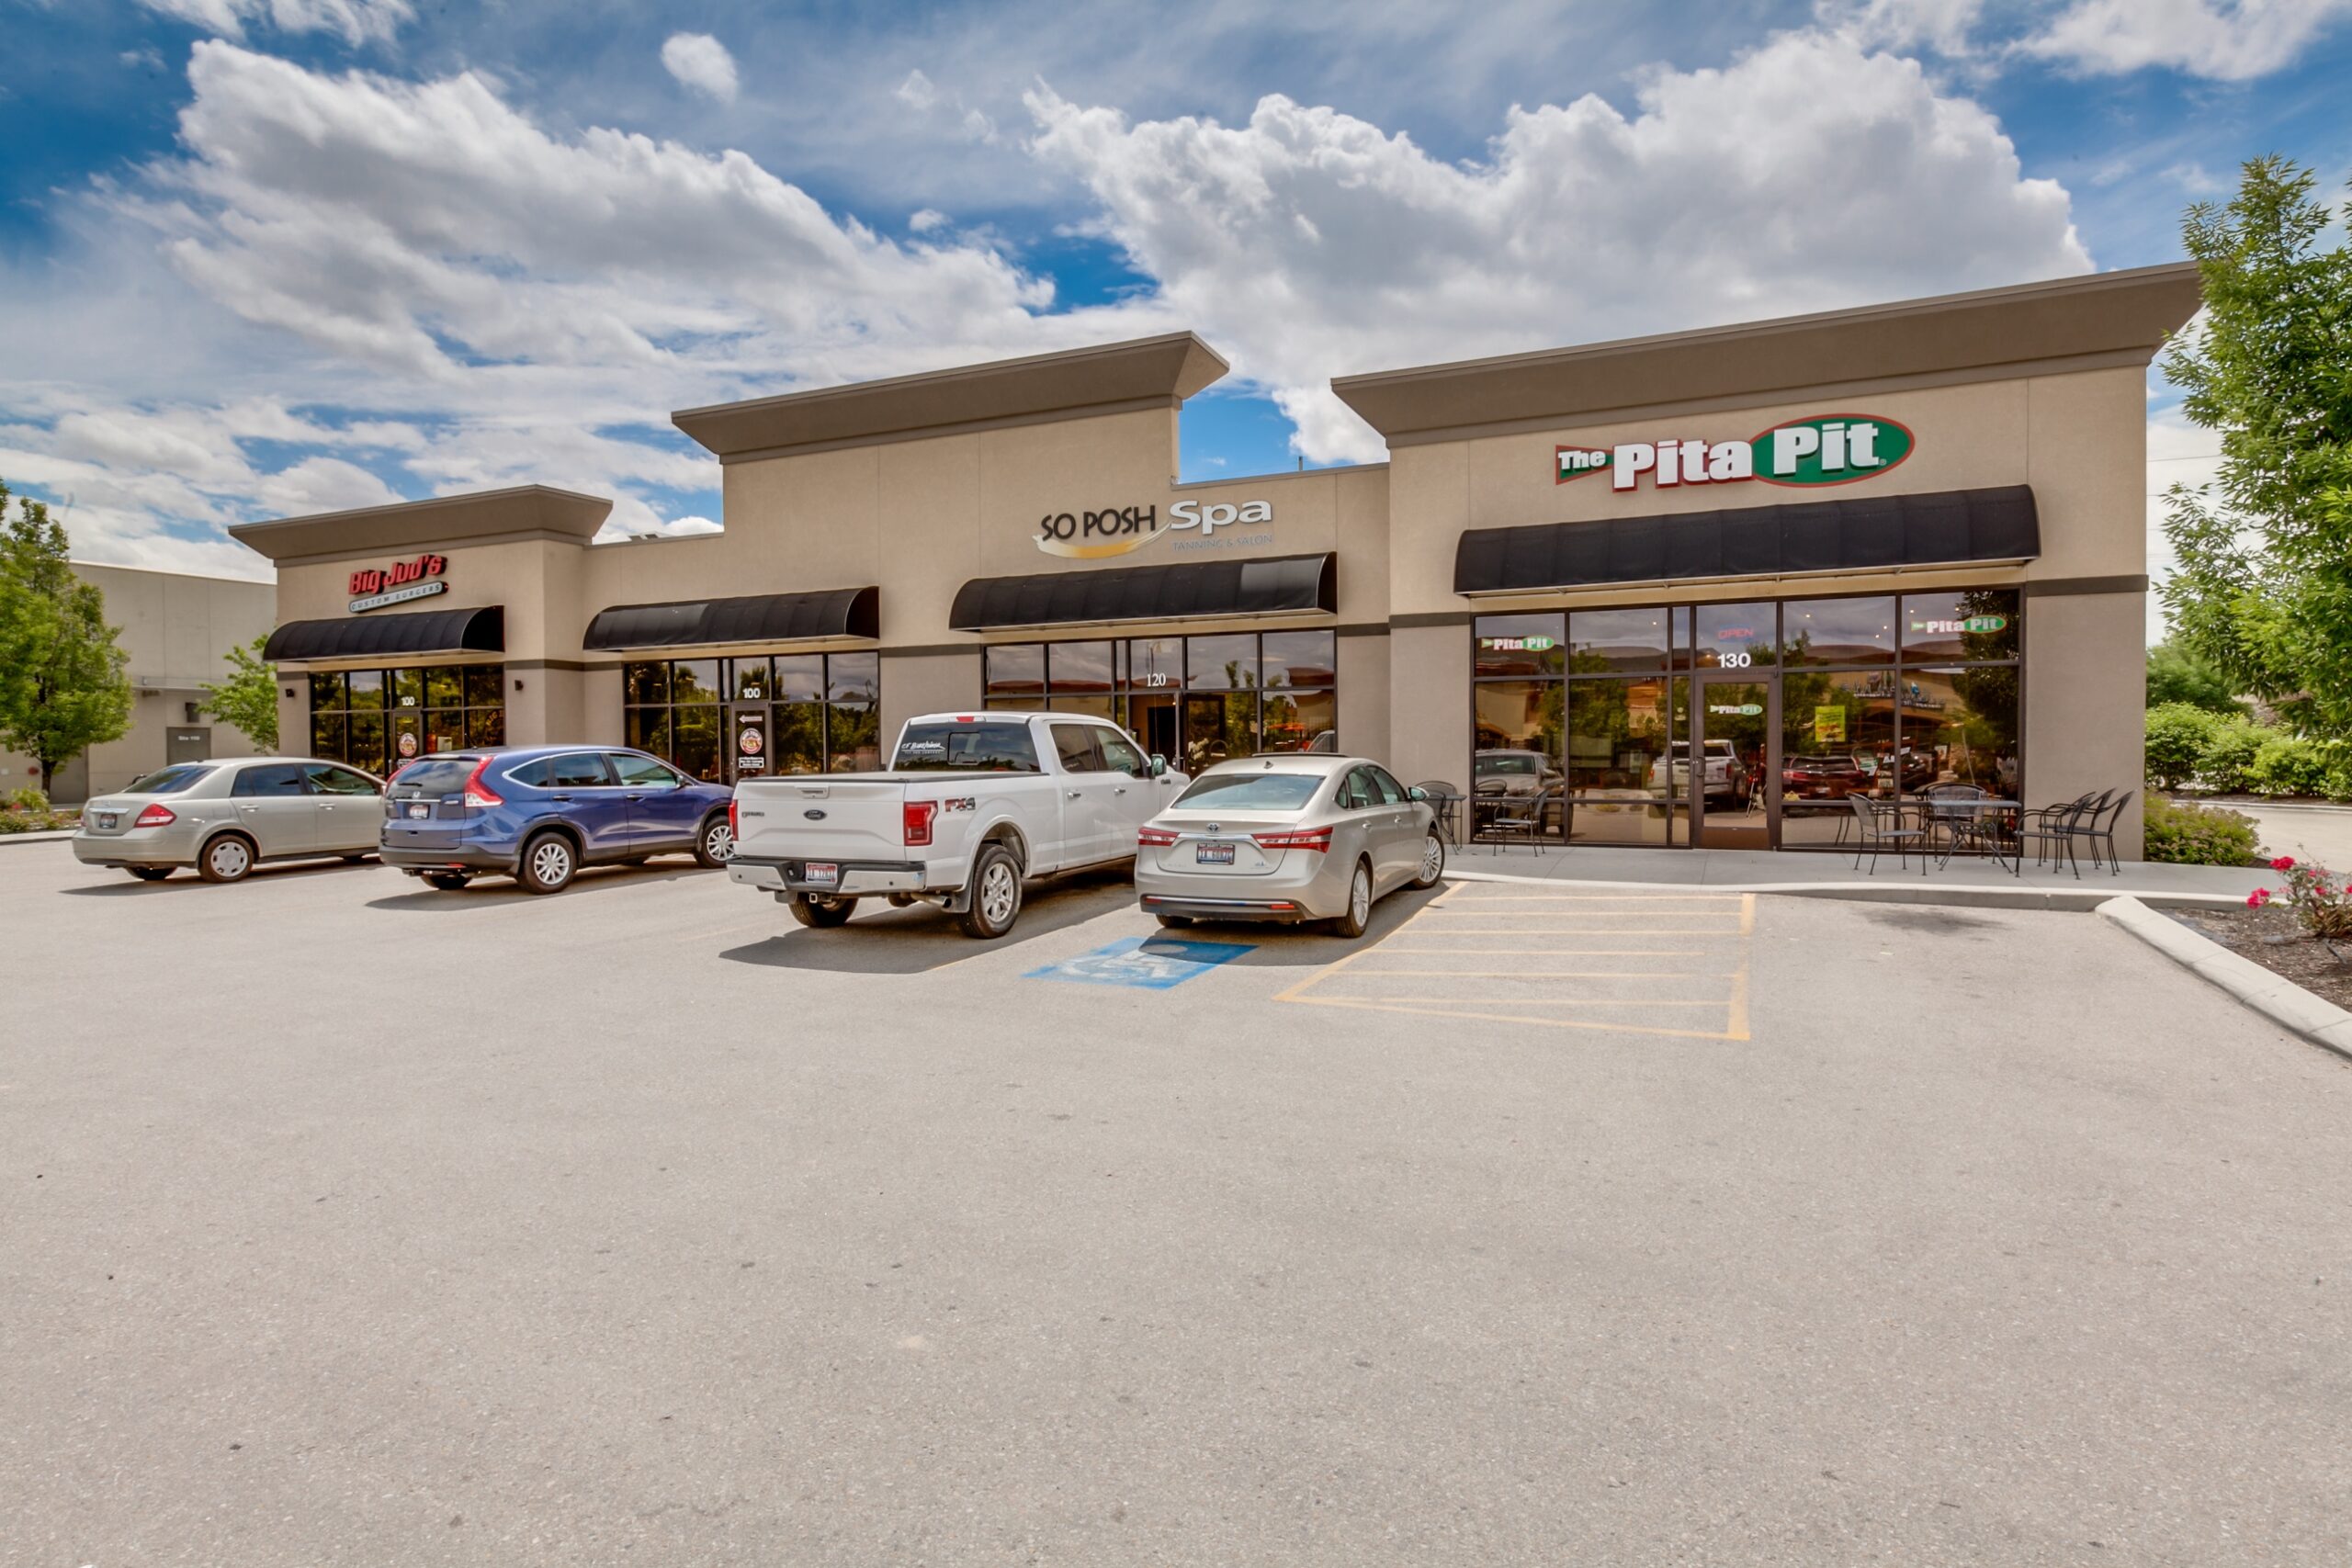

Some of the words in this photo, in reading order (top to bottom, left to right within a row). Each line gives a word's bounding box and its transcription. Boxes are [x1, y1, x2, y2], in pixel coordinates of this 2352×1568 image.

[1557, 449, 1607, 472] The
[1612, 438, 1753, 490] Pita
[1772, 422, 1880, 477] Pit
[1041, 513, 1077, 542] SO
[1083, 504, 1156, 538] POSH
[1169, 499, 1272, 536] Spa
[1172, 540, 1223, 551] TANNING
[1237, 535, 1273, 546] SALON
[348, 570, 383, 596] Big
[382, 553, 447, 587] Jud's
[351, 595, 390, 611] CUSTOM
[394, 582, 442, 601] BURGERS
[1718, 627, 1754, 639] OPEN
[1926, 620, 1966, 634] Pita
[1969, 617, 1998, 631] Pit
[1493, 637, 1523, 651] Pita
[1526, 637, 1548, 649] Pit
[1717, 652, 1752, 669] 130
[1147, 672, 1167, 687] 120
[401, 696, 415, 706] 100
[742, 687, 762, 699] 100
[944, 796, 976, 812] FX4
